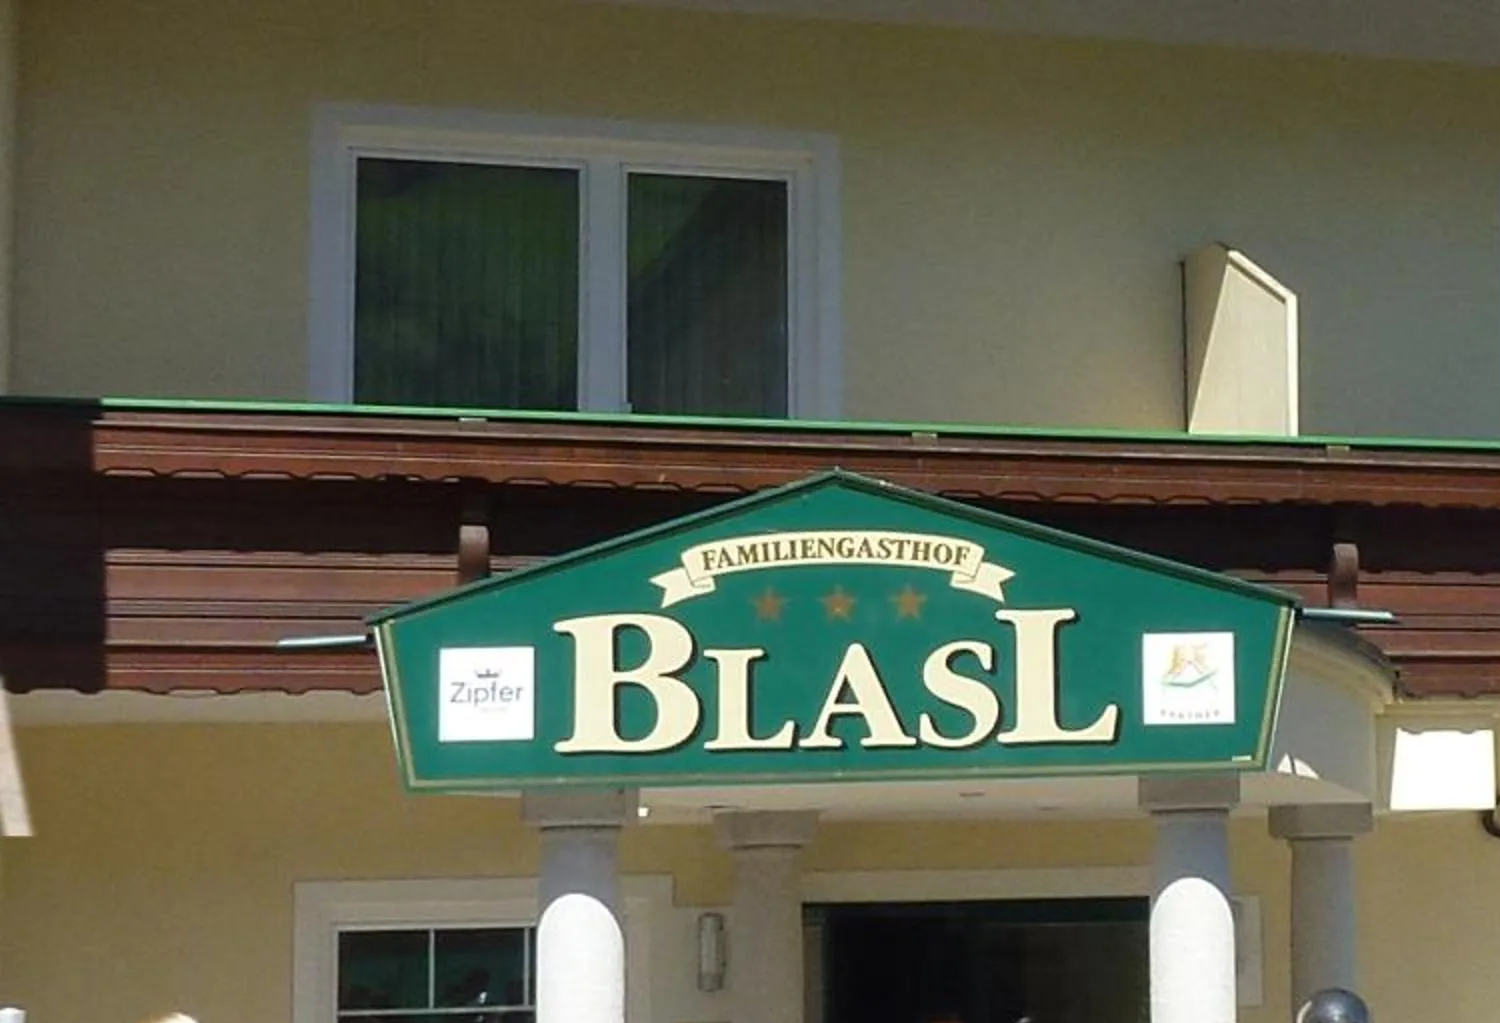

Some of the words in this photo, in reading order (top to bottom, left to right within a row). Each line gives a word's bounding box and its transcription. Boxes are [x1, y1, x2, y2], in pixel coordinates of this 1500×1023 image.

[701, 536, 972, 571] FAMILIENGASTHOF
[449, 679, 524, 708] Zipfer
[552, 608, 1119, 753] BLASL
